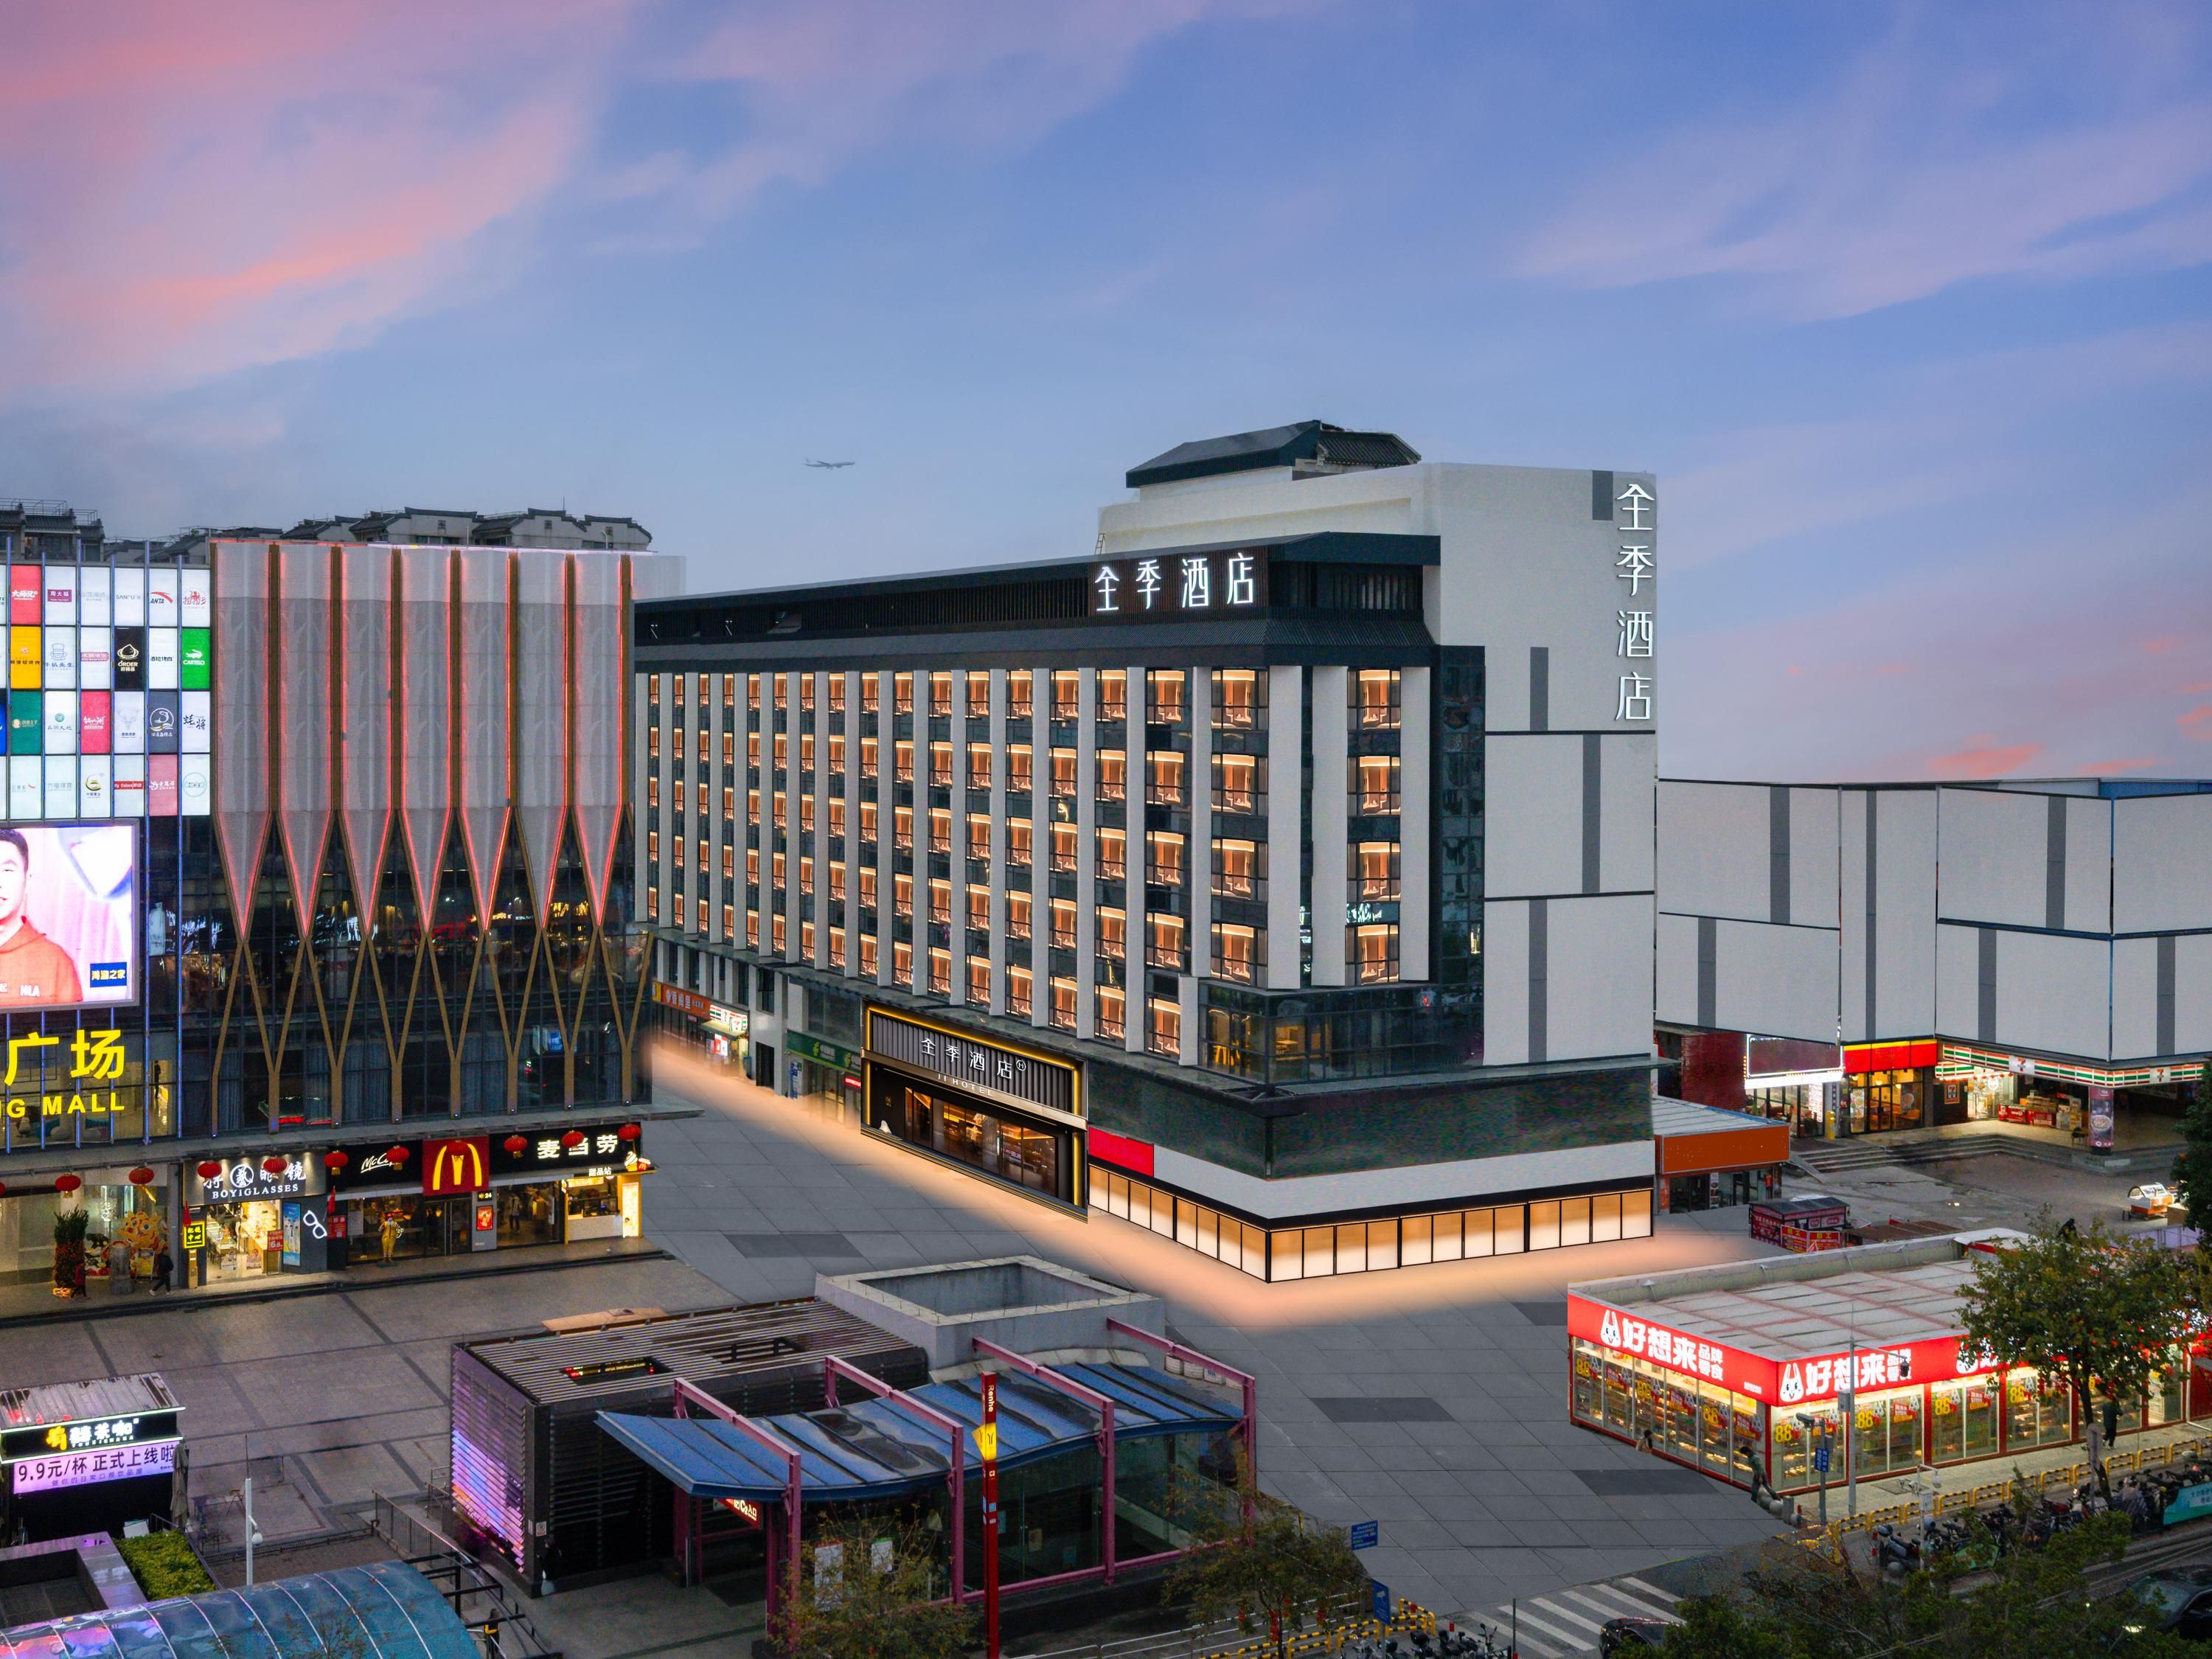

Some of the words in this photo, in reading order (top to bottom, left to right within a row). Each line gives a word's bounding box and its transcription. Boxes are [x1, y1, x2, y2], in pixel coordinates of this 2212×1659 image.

[1094, 552, 1254, 611] 全季酒店
[1615, 484, 1655, 721] 全季酒店
[4, 1028, 125, 1088] 广场
[921, 1037, 1012, 1080] 全季酒店
[937, 1074, 947, 1082] JI
[952, 1079, 992, 1097] HOTEL
[0, 1100, 26, 1119] G
[42, 1092, 125, 1116] MALL
[537, 1134, 619, 1159] 麦当劳
[588, 1166, 612, 1178] 甜品站
[212, 1183, 299, 1200] BOYIGLASSES
[1621, 1318, 1698, 1373] 好想来
[1698, 1343, 1723, 1364] 品牌
[1698, 1360, 1723, 1381] 零食
[1805, 1352, 1886, 1397] 好想来
[18, 1457, 88, 1482] 9.9元/杯
